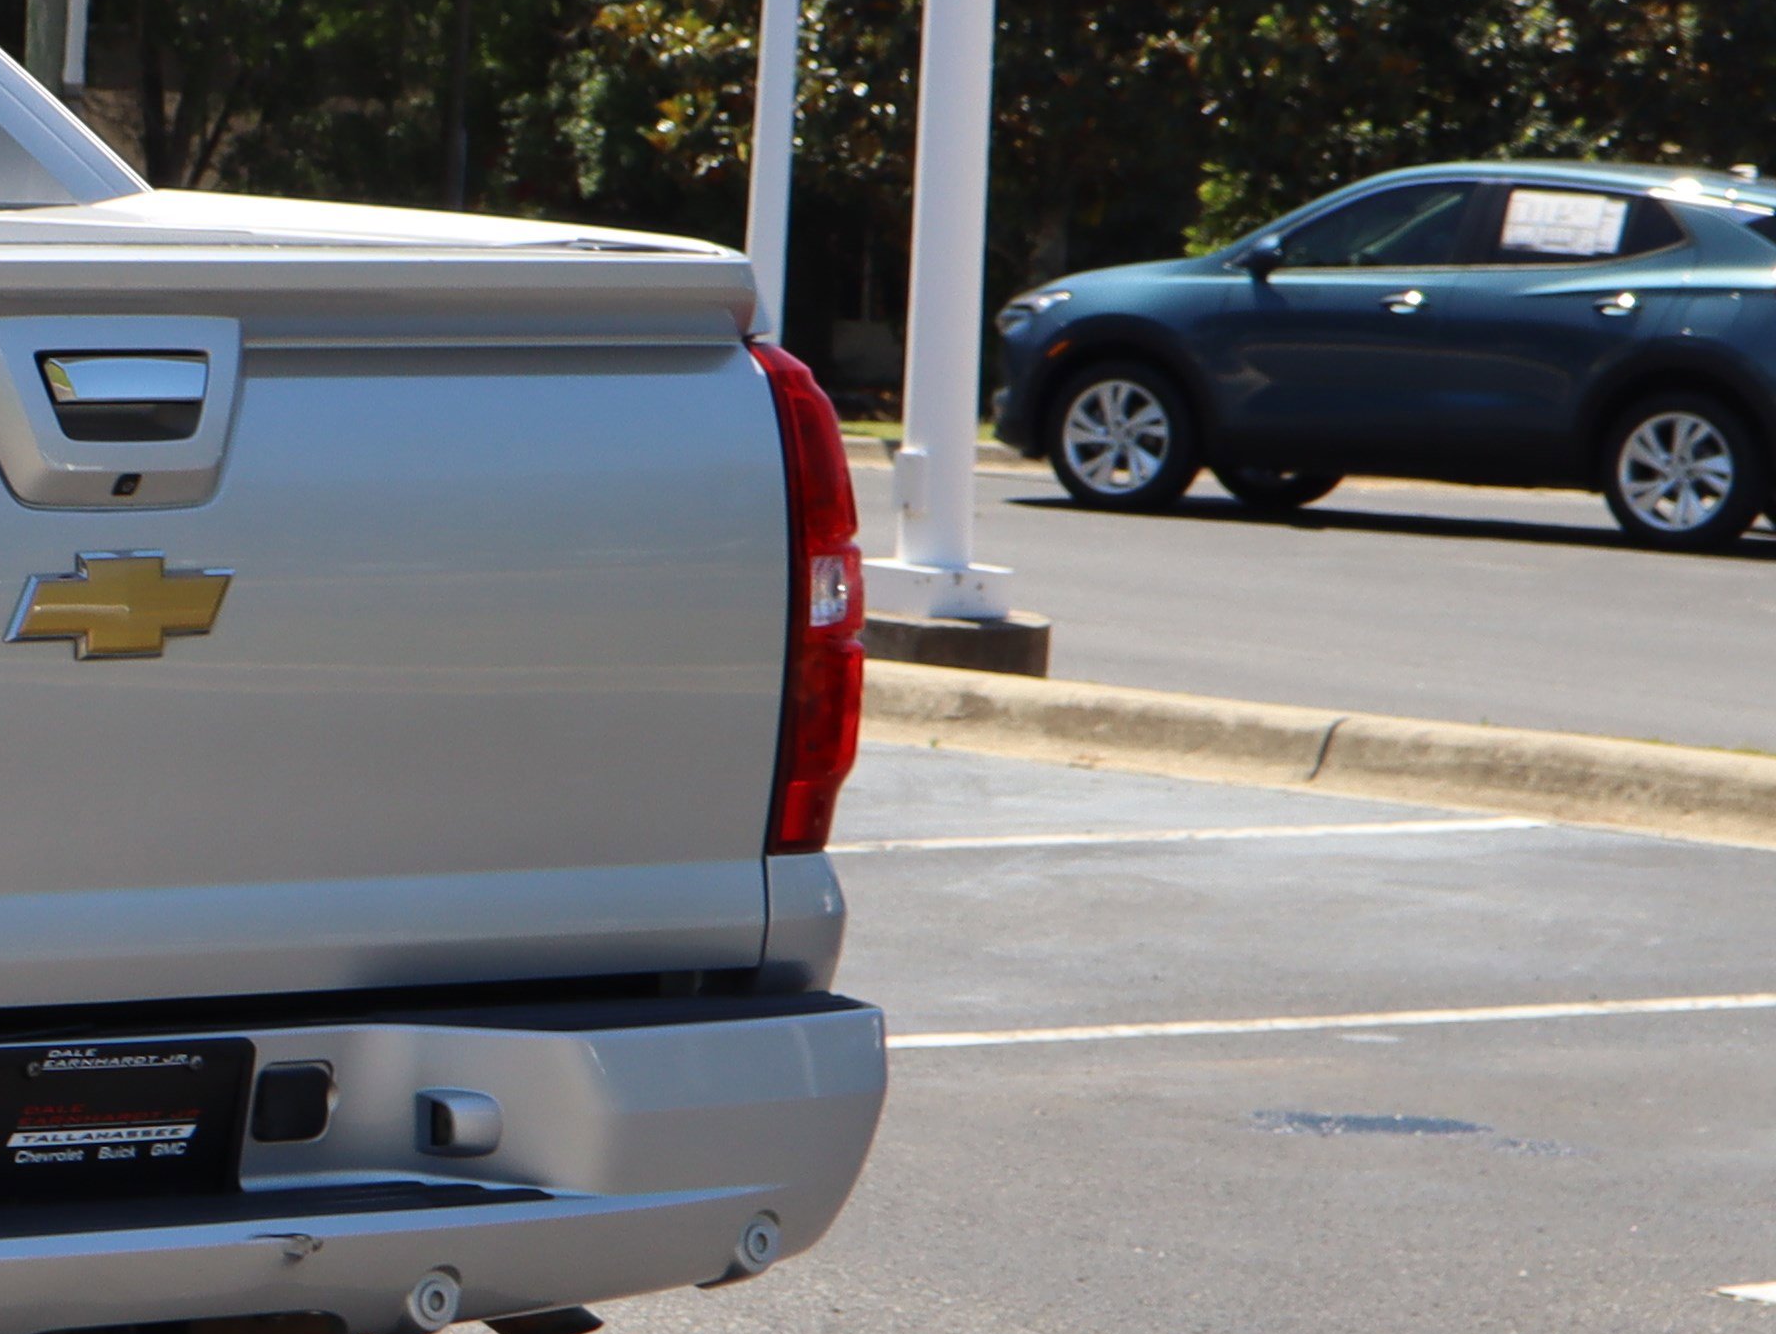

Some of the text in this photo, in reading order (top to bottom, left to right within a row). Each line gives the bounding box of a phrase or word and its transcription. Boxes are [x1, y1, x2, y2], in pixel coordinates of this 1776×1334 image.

[48, 1048, 97, 1058] DALE
[43, 1055, 158, 1069] EARNHARDT
[22, 1104, 86, 1115] DALE
[17, 1112, 161, 1127] EARNHARDT
[21, 1127, 185, 1144] TALLAHASSEE
[14, 1142, 188, 1164] Chevrolet Buick GMC
